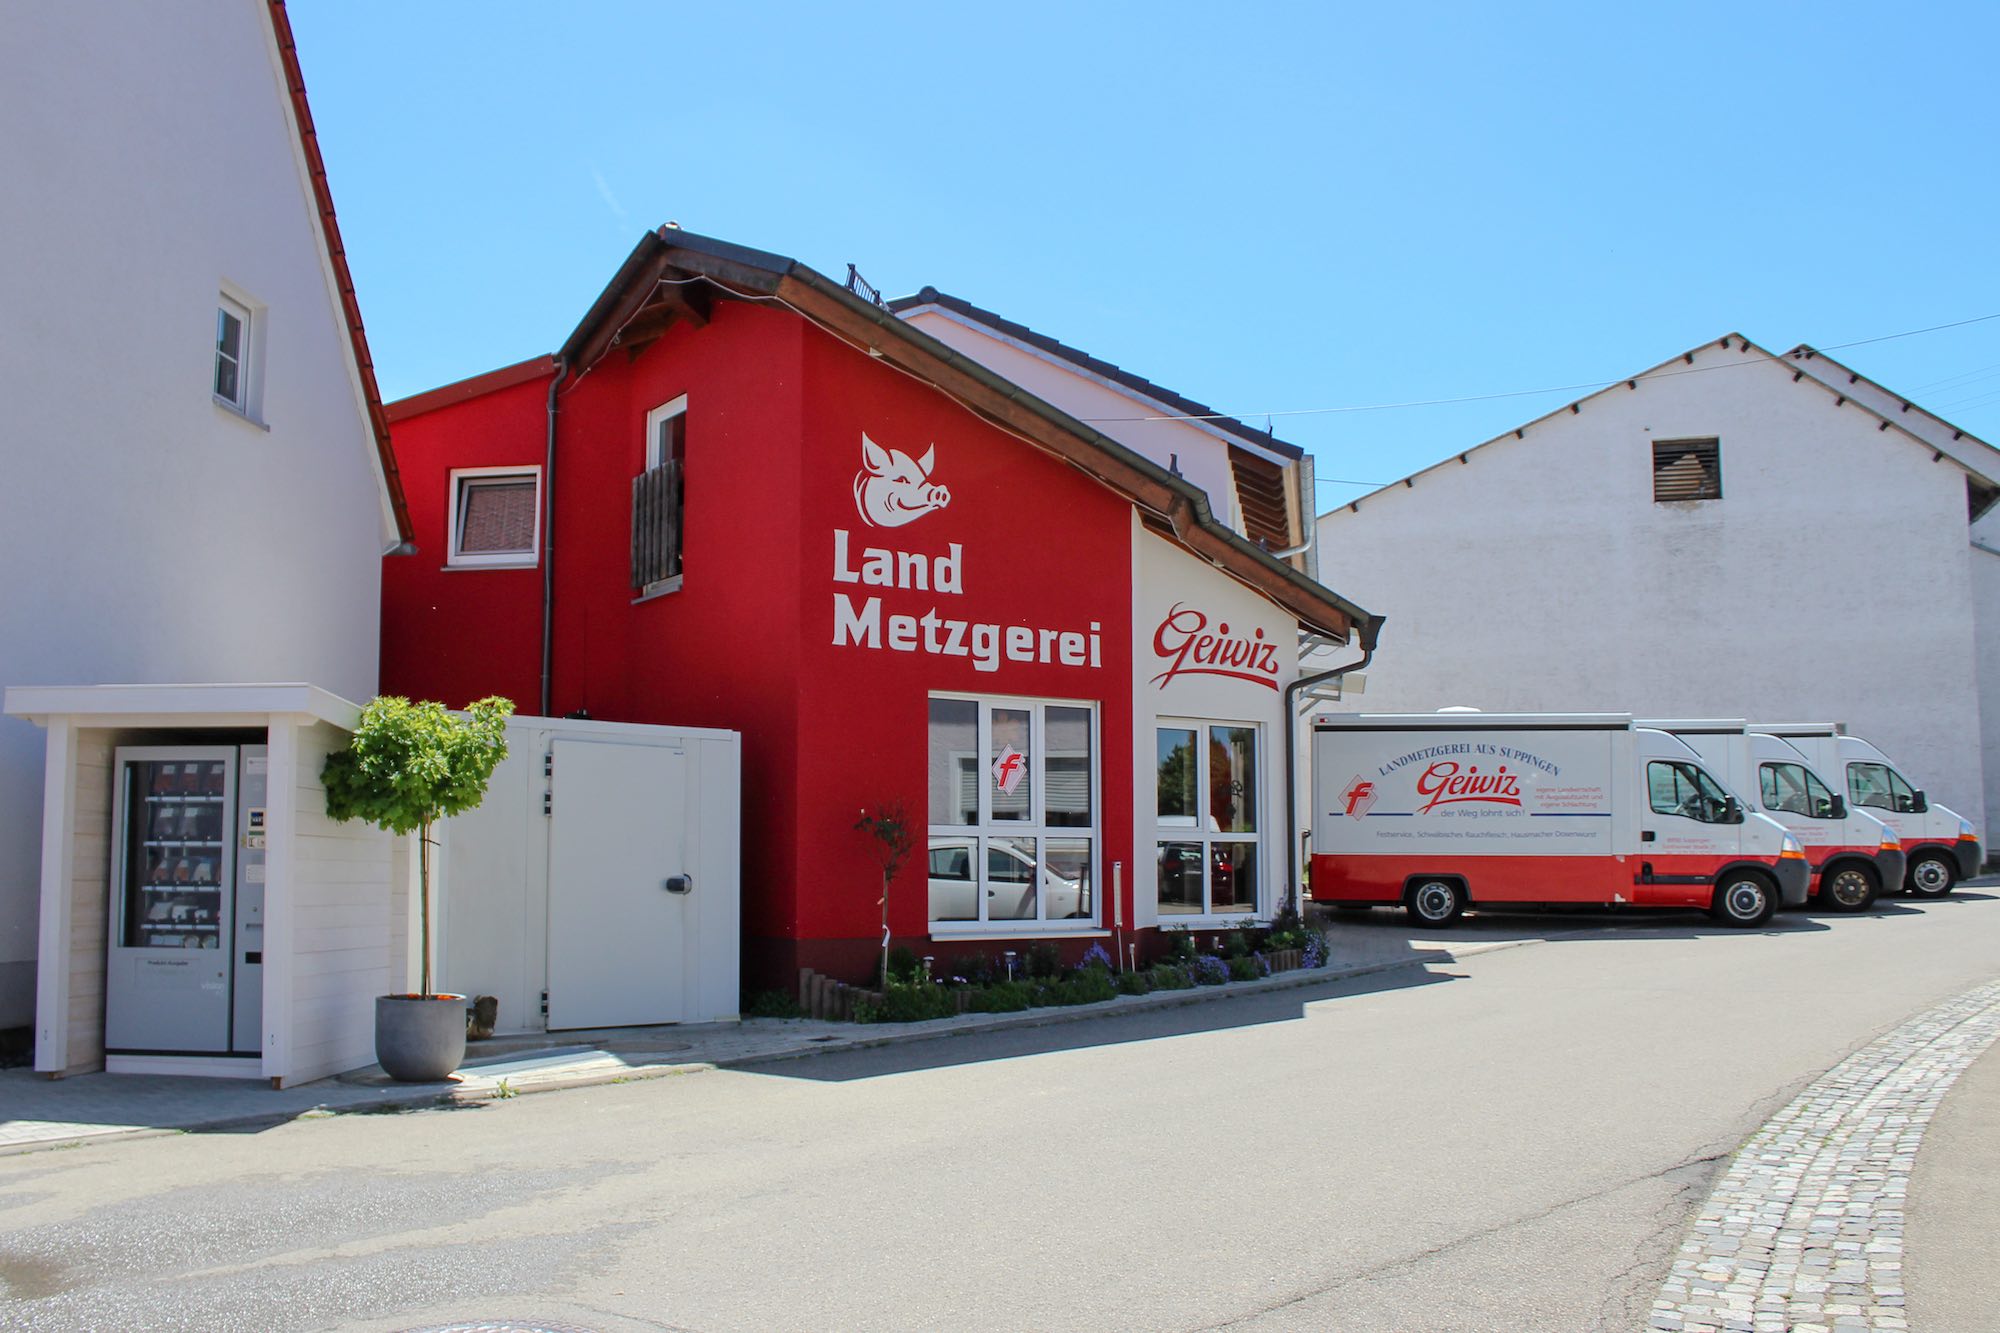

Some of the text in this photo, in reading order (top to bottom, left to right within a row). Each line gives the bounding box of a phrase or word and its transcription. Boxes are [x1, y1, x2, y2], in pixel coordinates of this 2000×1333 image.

[833, 529, 963, 595] Land
[831, 592, 1102, 673] Metzgerei
[1149, 601, 1279, 692] Geiwiz
[1378, 743, 1562, 777] LANDMETZGEREI AUS SUPPINGEN
[1416, 761, 1522, 815] Geiwiz
[1458, 809, 1478, 819] Weg
[1480, 809, 1503, 817] lohnt
